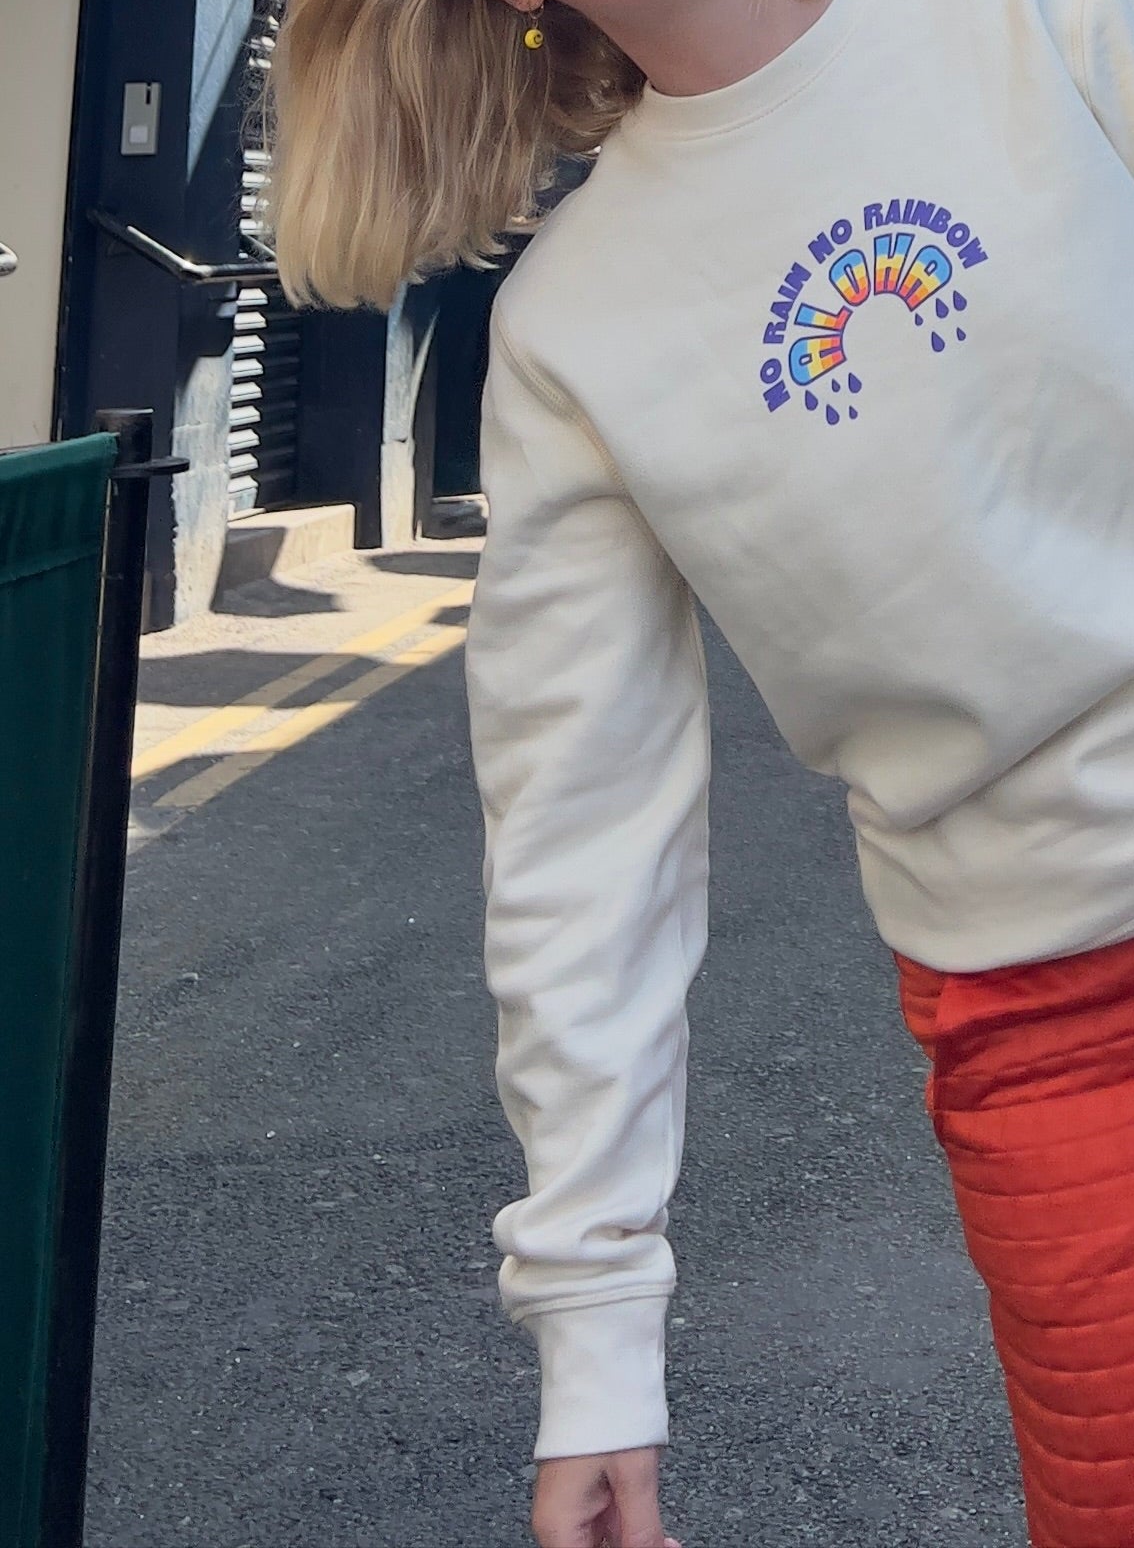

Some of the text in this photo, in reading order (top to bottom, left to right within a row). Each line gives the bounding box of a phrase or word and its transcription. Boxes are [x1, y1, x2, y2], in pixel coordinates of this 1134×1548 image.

[760, 199, 988, 412] NO RAIN NO RAINBOW
[789, 233, 952, 386] ALOHA
